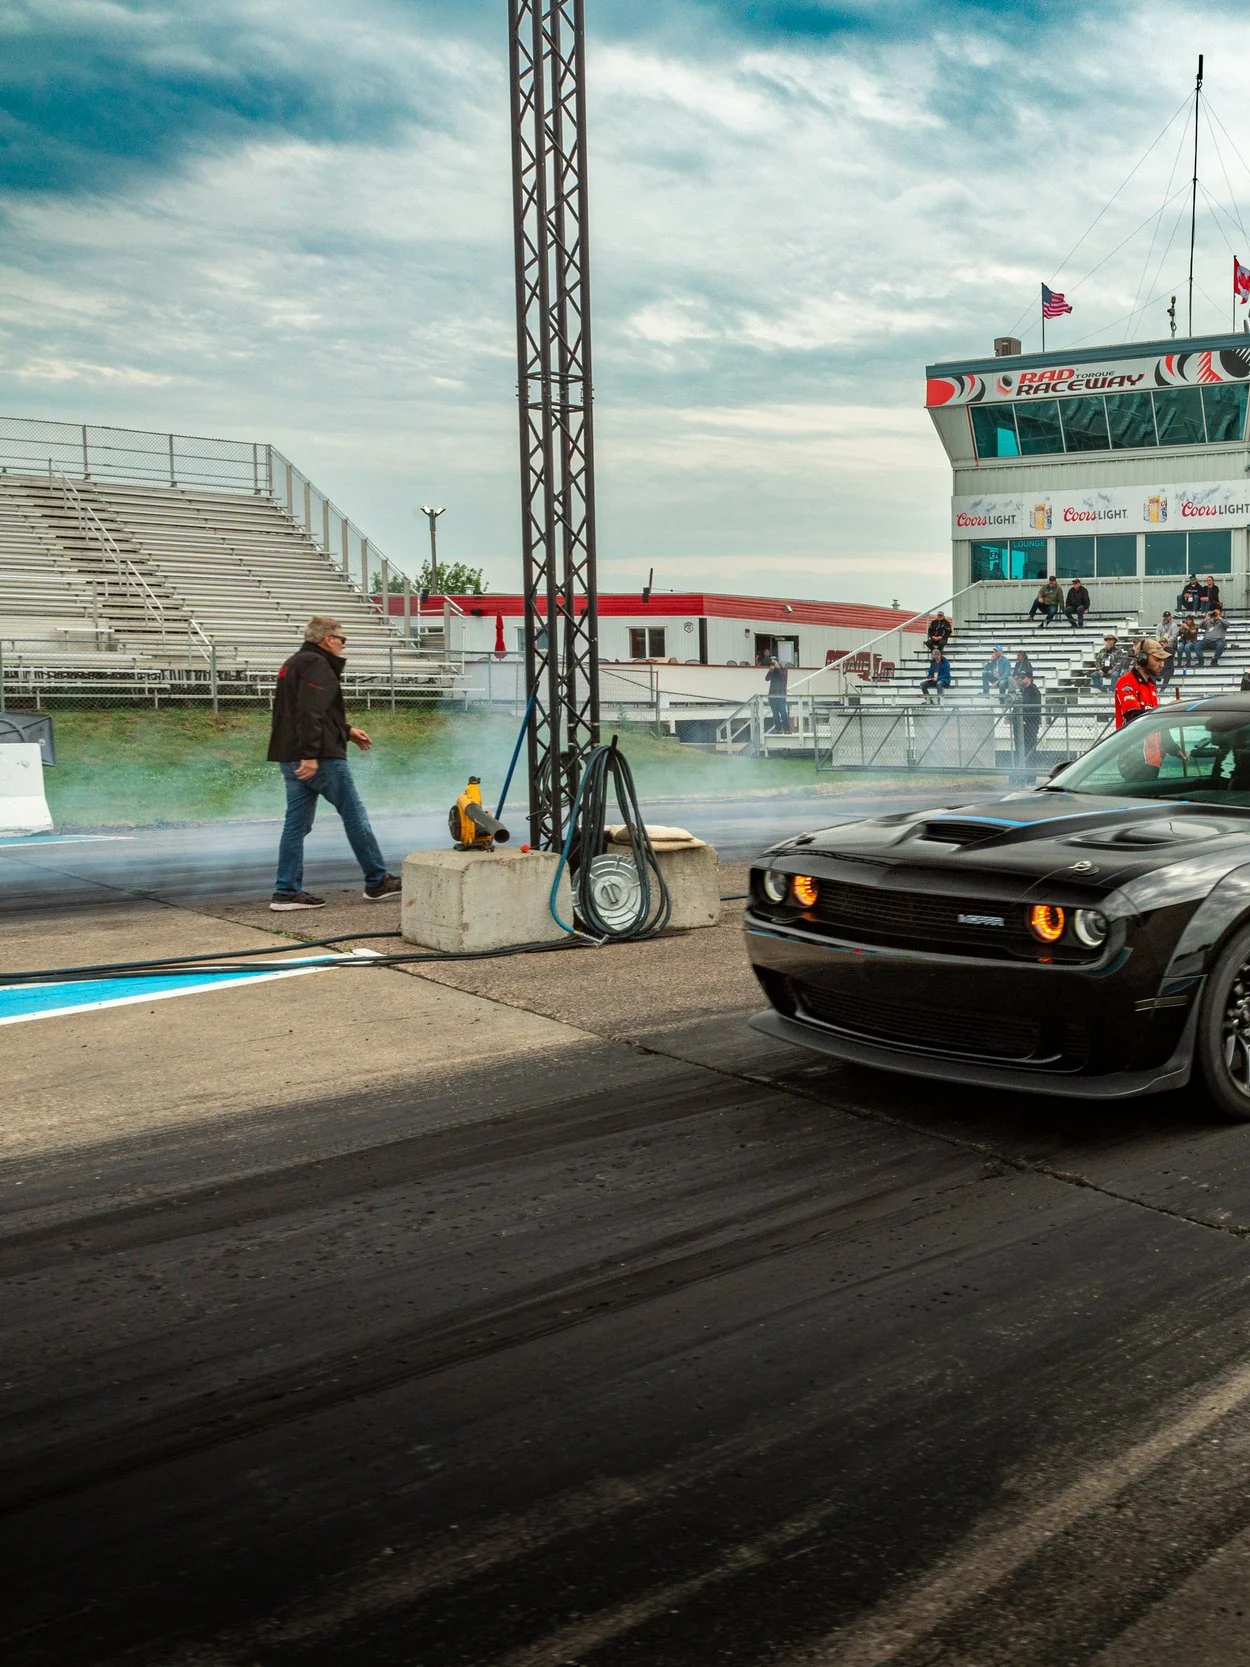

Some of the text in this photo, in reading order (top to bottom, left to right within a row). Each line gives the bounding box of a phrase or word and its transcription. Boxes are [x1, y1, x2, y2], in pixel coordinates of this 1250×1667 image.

[1019, 368, 1115, 384] RAD TORQUE
[1016, 374, 1145, 396] RACEWAY
[1063, 506, 1128, 522] Coors LIGHT
[1181, 501, 1250, 517] Coors LIGHT
[956, 512, 1017, 527] Coors LIGHT
[1013, 540, 1046, 548] LOUNGE
